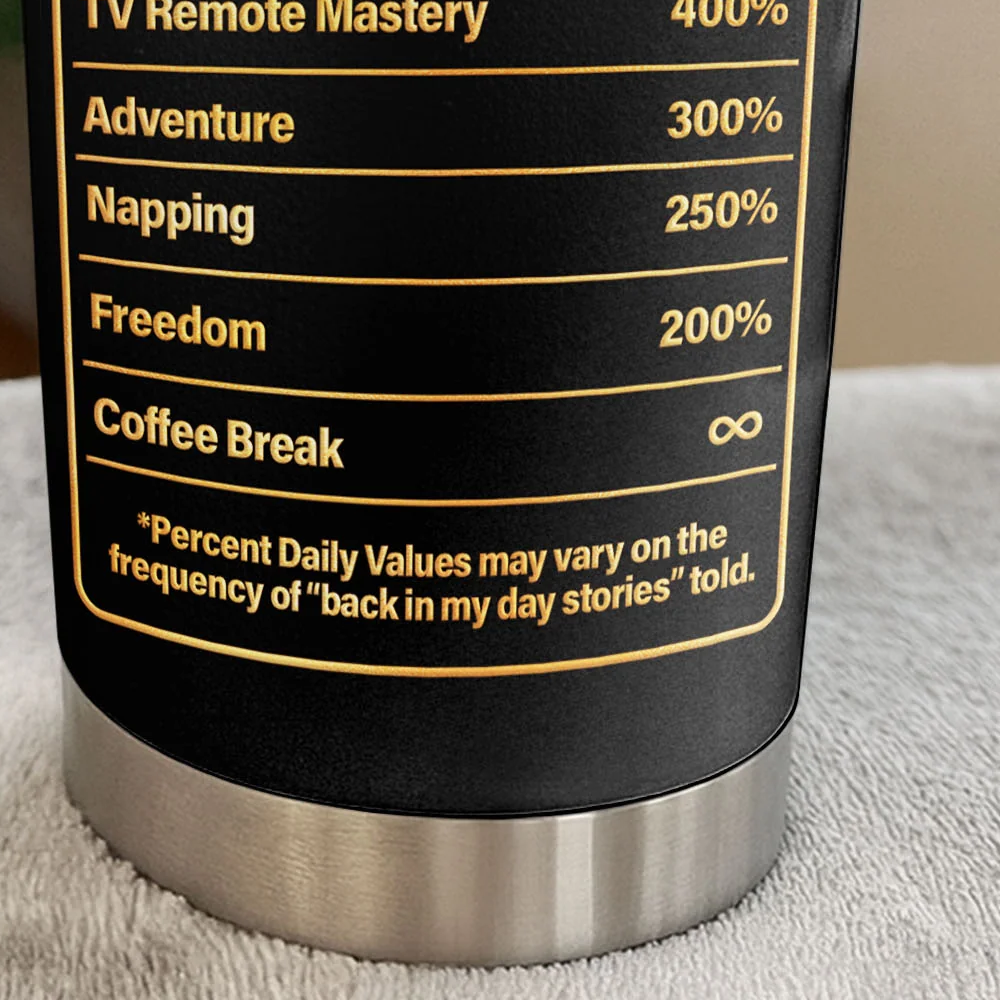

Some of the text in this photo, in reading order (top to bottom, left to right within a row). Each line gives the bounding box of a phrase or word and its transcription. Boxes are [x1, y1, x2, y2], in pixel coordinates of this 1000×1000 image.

[84, 96, 782, 143] Adventure 300%
[88, 185, 777, 245] Napping 250%
[91, 293, 771, 351] Freedom 200%
[94, 398, 218, 453] Coffee
[228, 420, 343, 468] Break
[279, 537, 358, 581] Daily
[365, 544, 471, 577] Values
[480, 550, 547, 583] may
[554, 542, 624, 575] vary
[631, 536, 670, 563] on
[677, 523, 728, 555] the
[108, 543, 264, 613] frequency
[271, 580, 301, 611] of
[405, 588, 433, 621] in
[442, 597, 491, 629] my
[498, 587, 556, 626] day
[690, 552, 754, 595] told.
